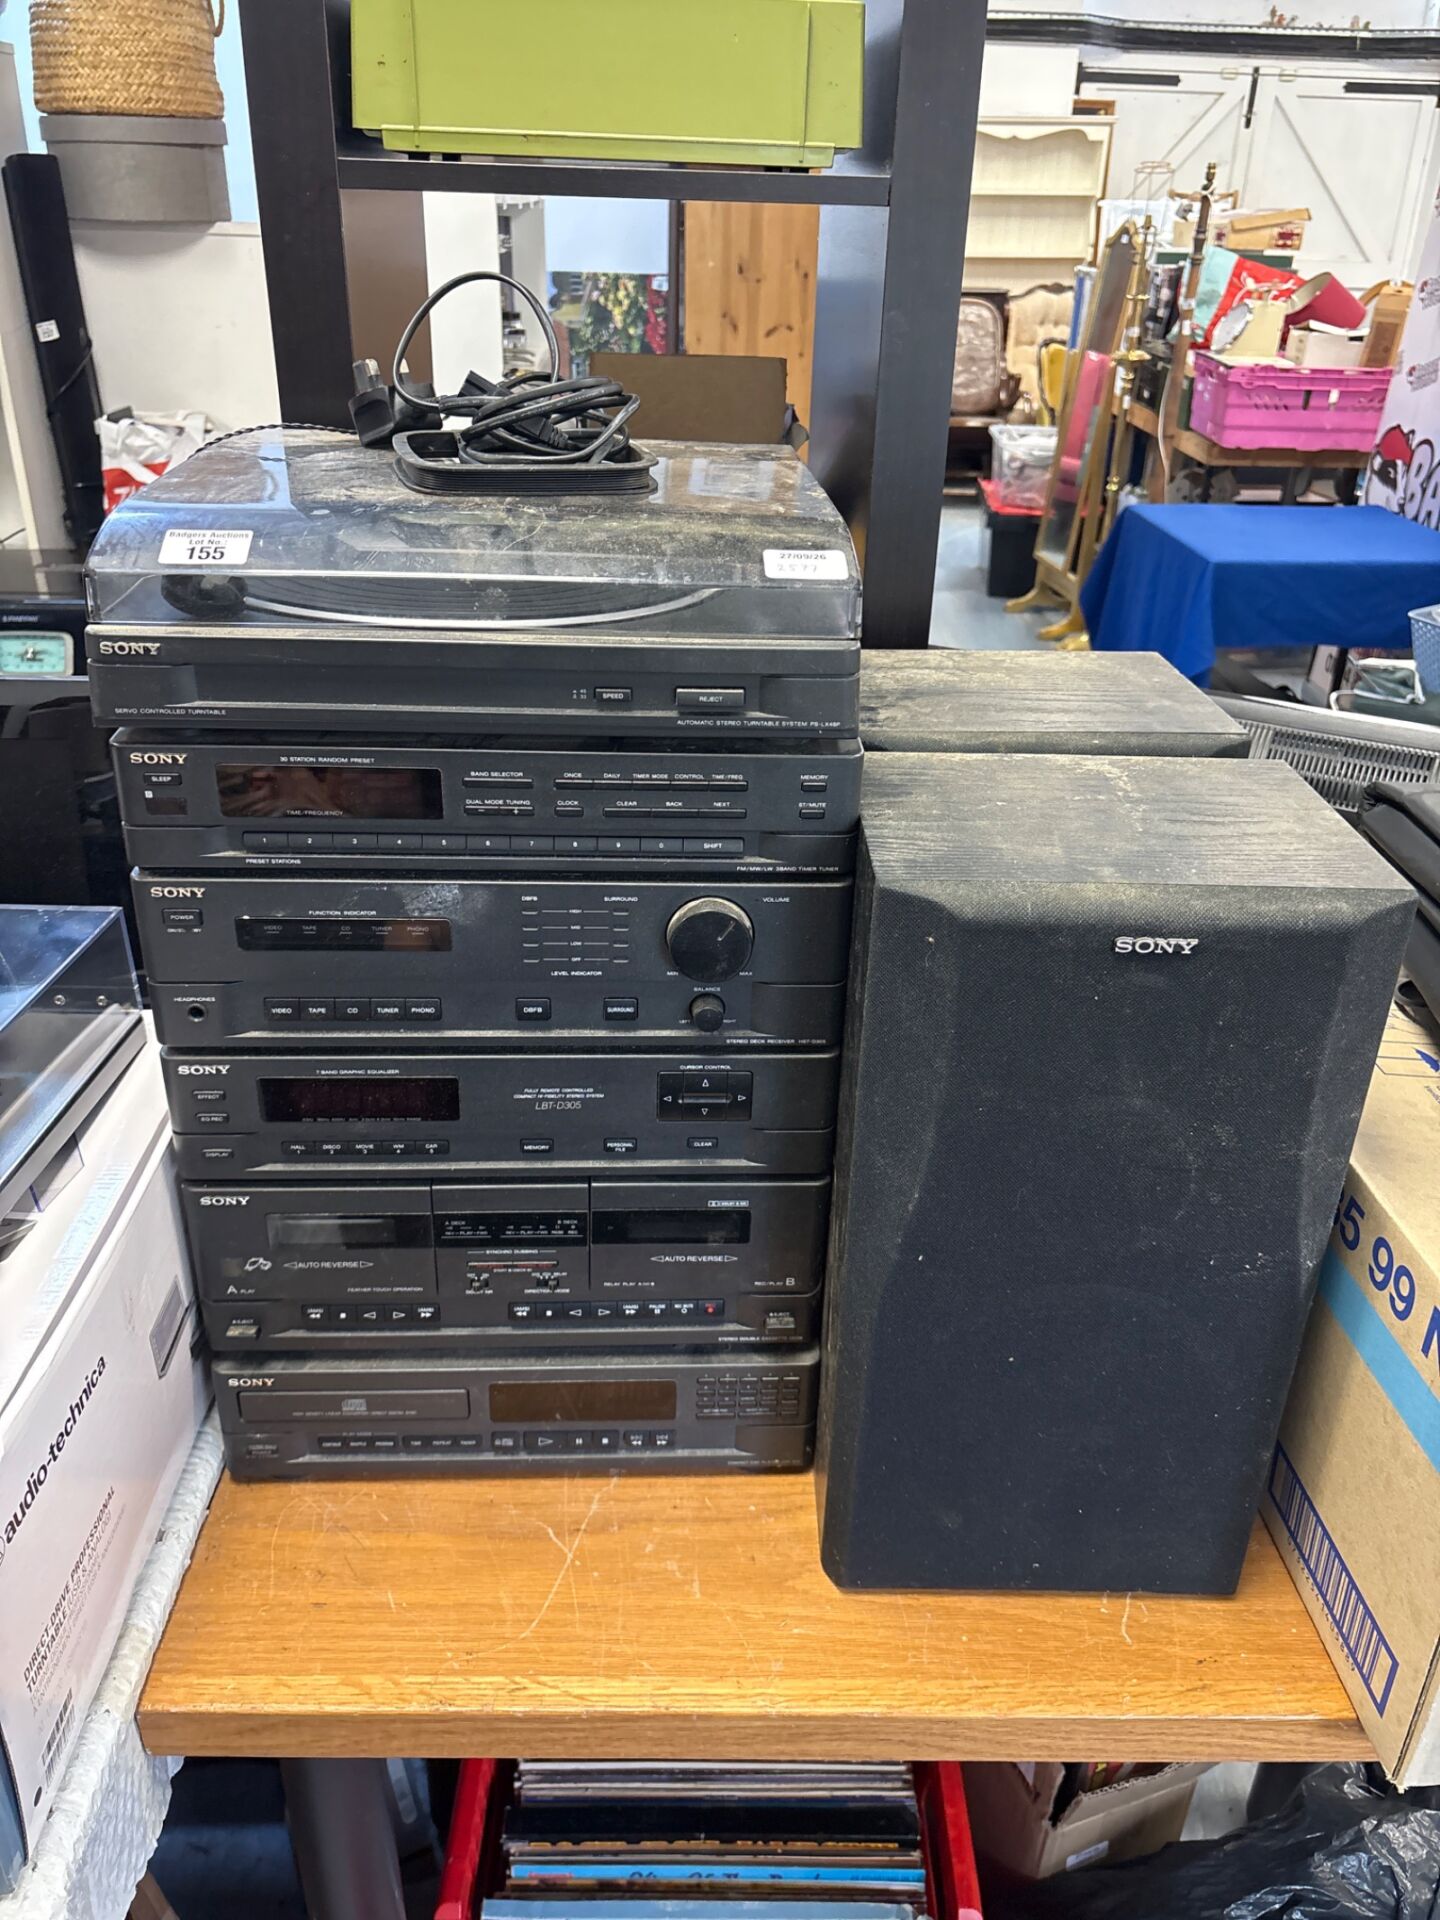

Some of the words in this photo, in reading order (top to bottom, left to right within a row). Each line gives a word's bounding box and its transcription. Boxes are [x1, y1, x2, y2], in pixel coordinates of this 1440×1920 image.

[169, 531, 207, 539] Badgers
[187, 546, 226, 560] 155
[99, 641, 161, 656] SONY
[699, 695, 723, 703] REJECT
[114, 707, 138, 715] SERVO
[139, 707, 186, 715] CONTROLLED
[187, 708, 227, 716] TURNTABLE
[130, 752, 187, 765] SONY
[150, 886, 206, 898] SONY
[1114, 936, 1199, 954] SONY
[177, 1065, 231, 1075] SONY
[535, 1101, 582, 1110] LBT-D305
[199, 1196, 250, 1206] SONY
[786, 1277, 795, 1286] B
[1368, 1236, 1416, 1322] 99
[227, 1285, 238, 1294] A
[227, 1378, 275, 1387] SONY
[5, 1355, 107, 1545] audio-technica
[23, 1579, 70, 1683] DIRECT-DRIVE
[70, 1486, 115, 1582] PROFESSIONAL
[26, 1606, 68, 1694] TURNTABLE
